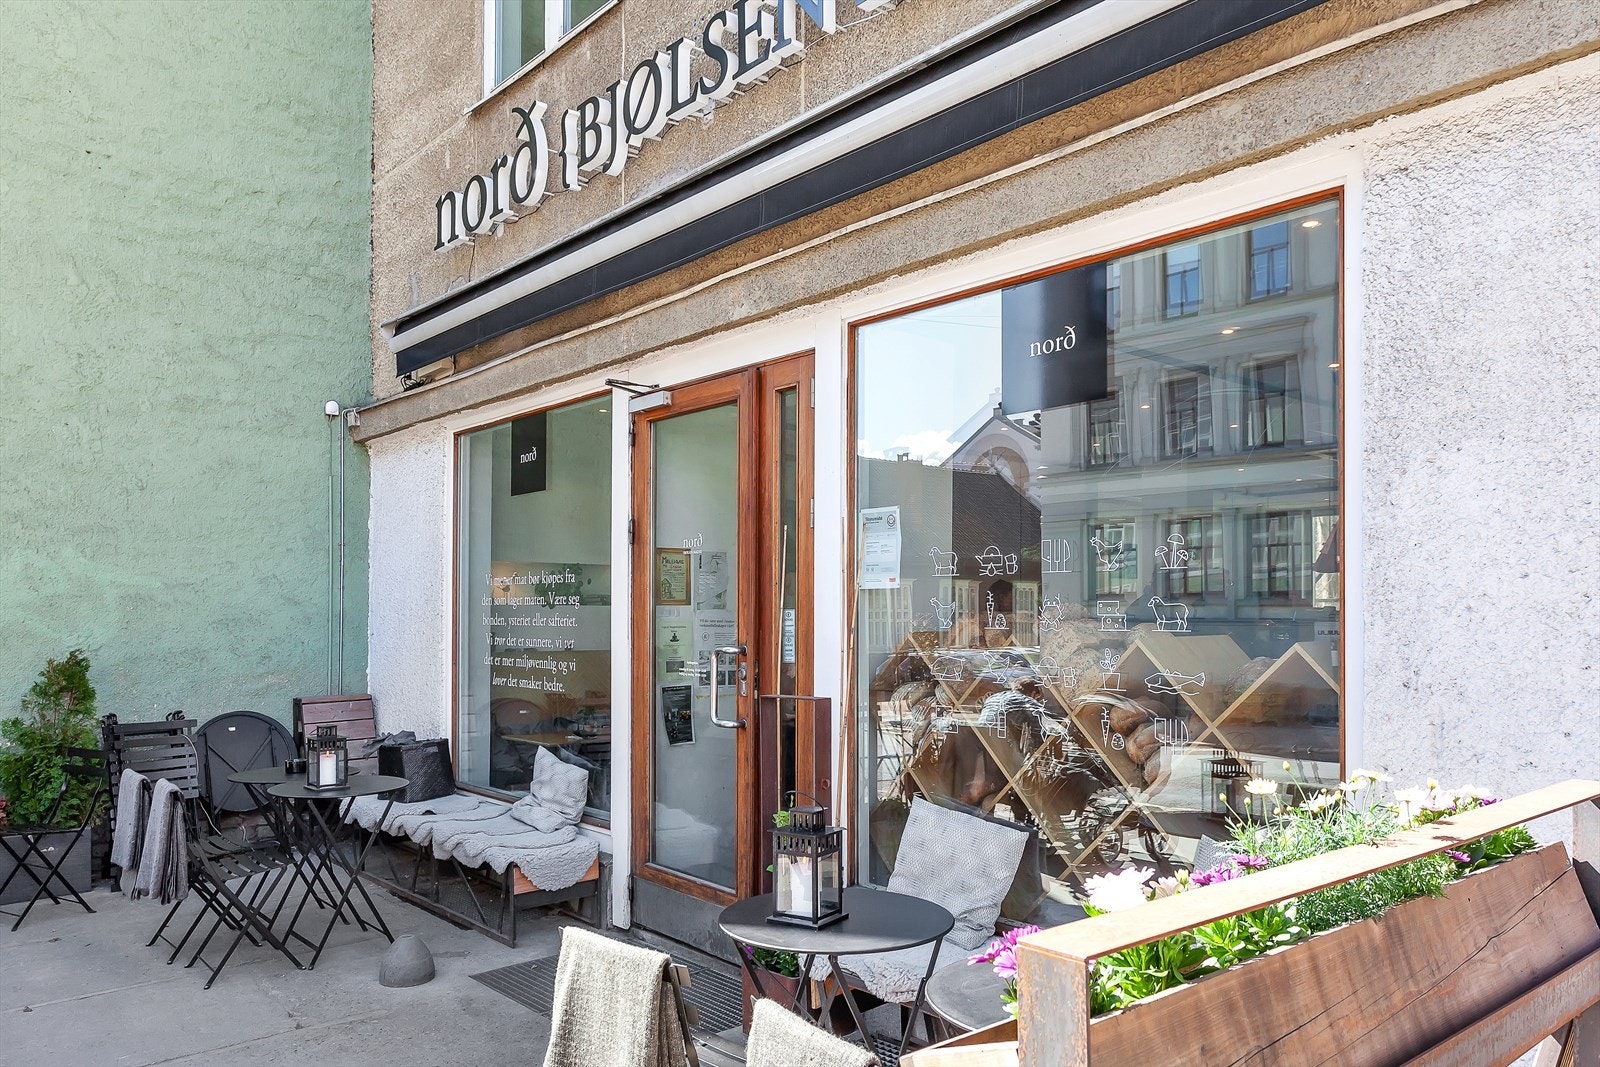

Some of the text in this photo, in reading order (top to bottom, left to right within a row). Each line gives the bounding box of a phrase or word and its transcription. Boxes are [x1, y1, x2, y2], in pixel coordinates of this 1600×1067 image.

[1029, 325, 1076, 357] norð
[514, 574, 528, 585] mat
[528, 571, 541, 585] bør
[541, 570, 564, 588] kjøpes
[565, 568, 576, 583] fra
[481, 593, 493, 606] den
[524, 595, 547, 606] maten.
[548, 591, 567, 605] Være
[568, 595, 580, 610] seg
[532, 612, 547, 626] eller
[547, 612, 578, 627] safteriet.
[506, 633, 517, 646] det
[518, 638, 525, 647] er
[525, 637, 554, 649] sunnere,
[555, 636, 562, 648] vi
[483, 652, 576, 675] det er mer miljøvennlig og vi
[507, 674, 518, 688] det
[518, 675, 542, 690] smaker
[543, 676, 565, 692] bedre.
